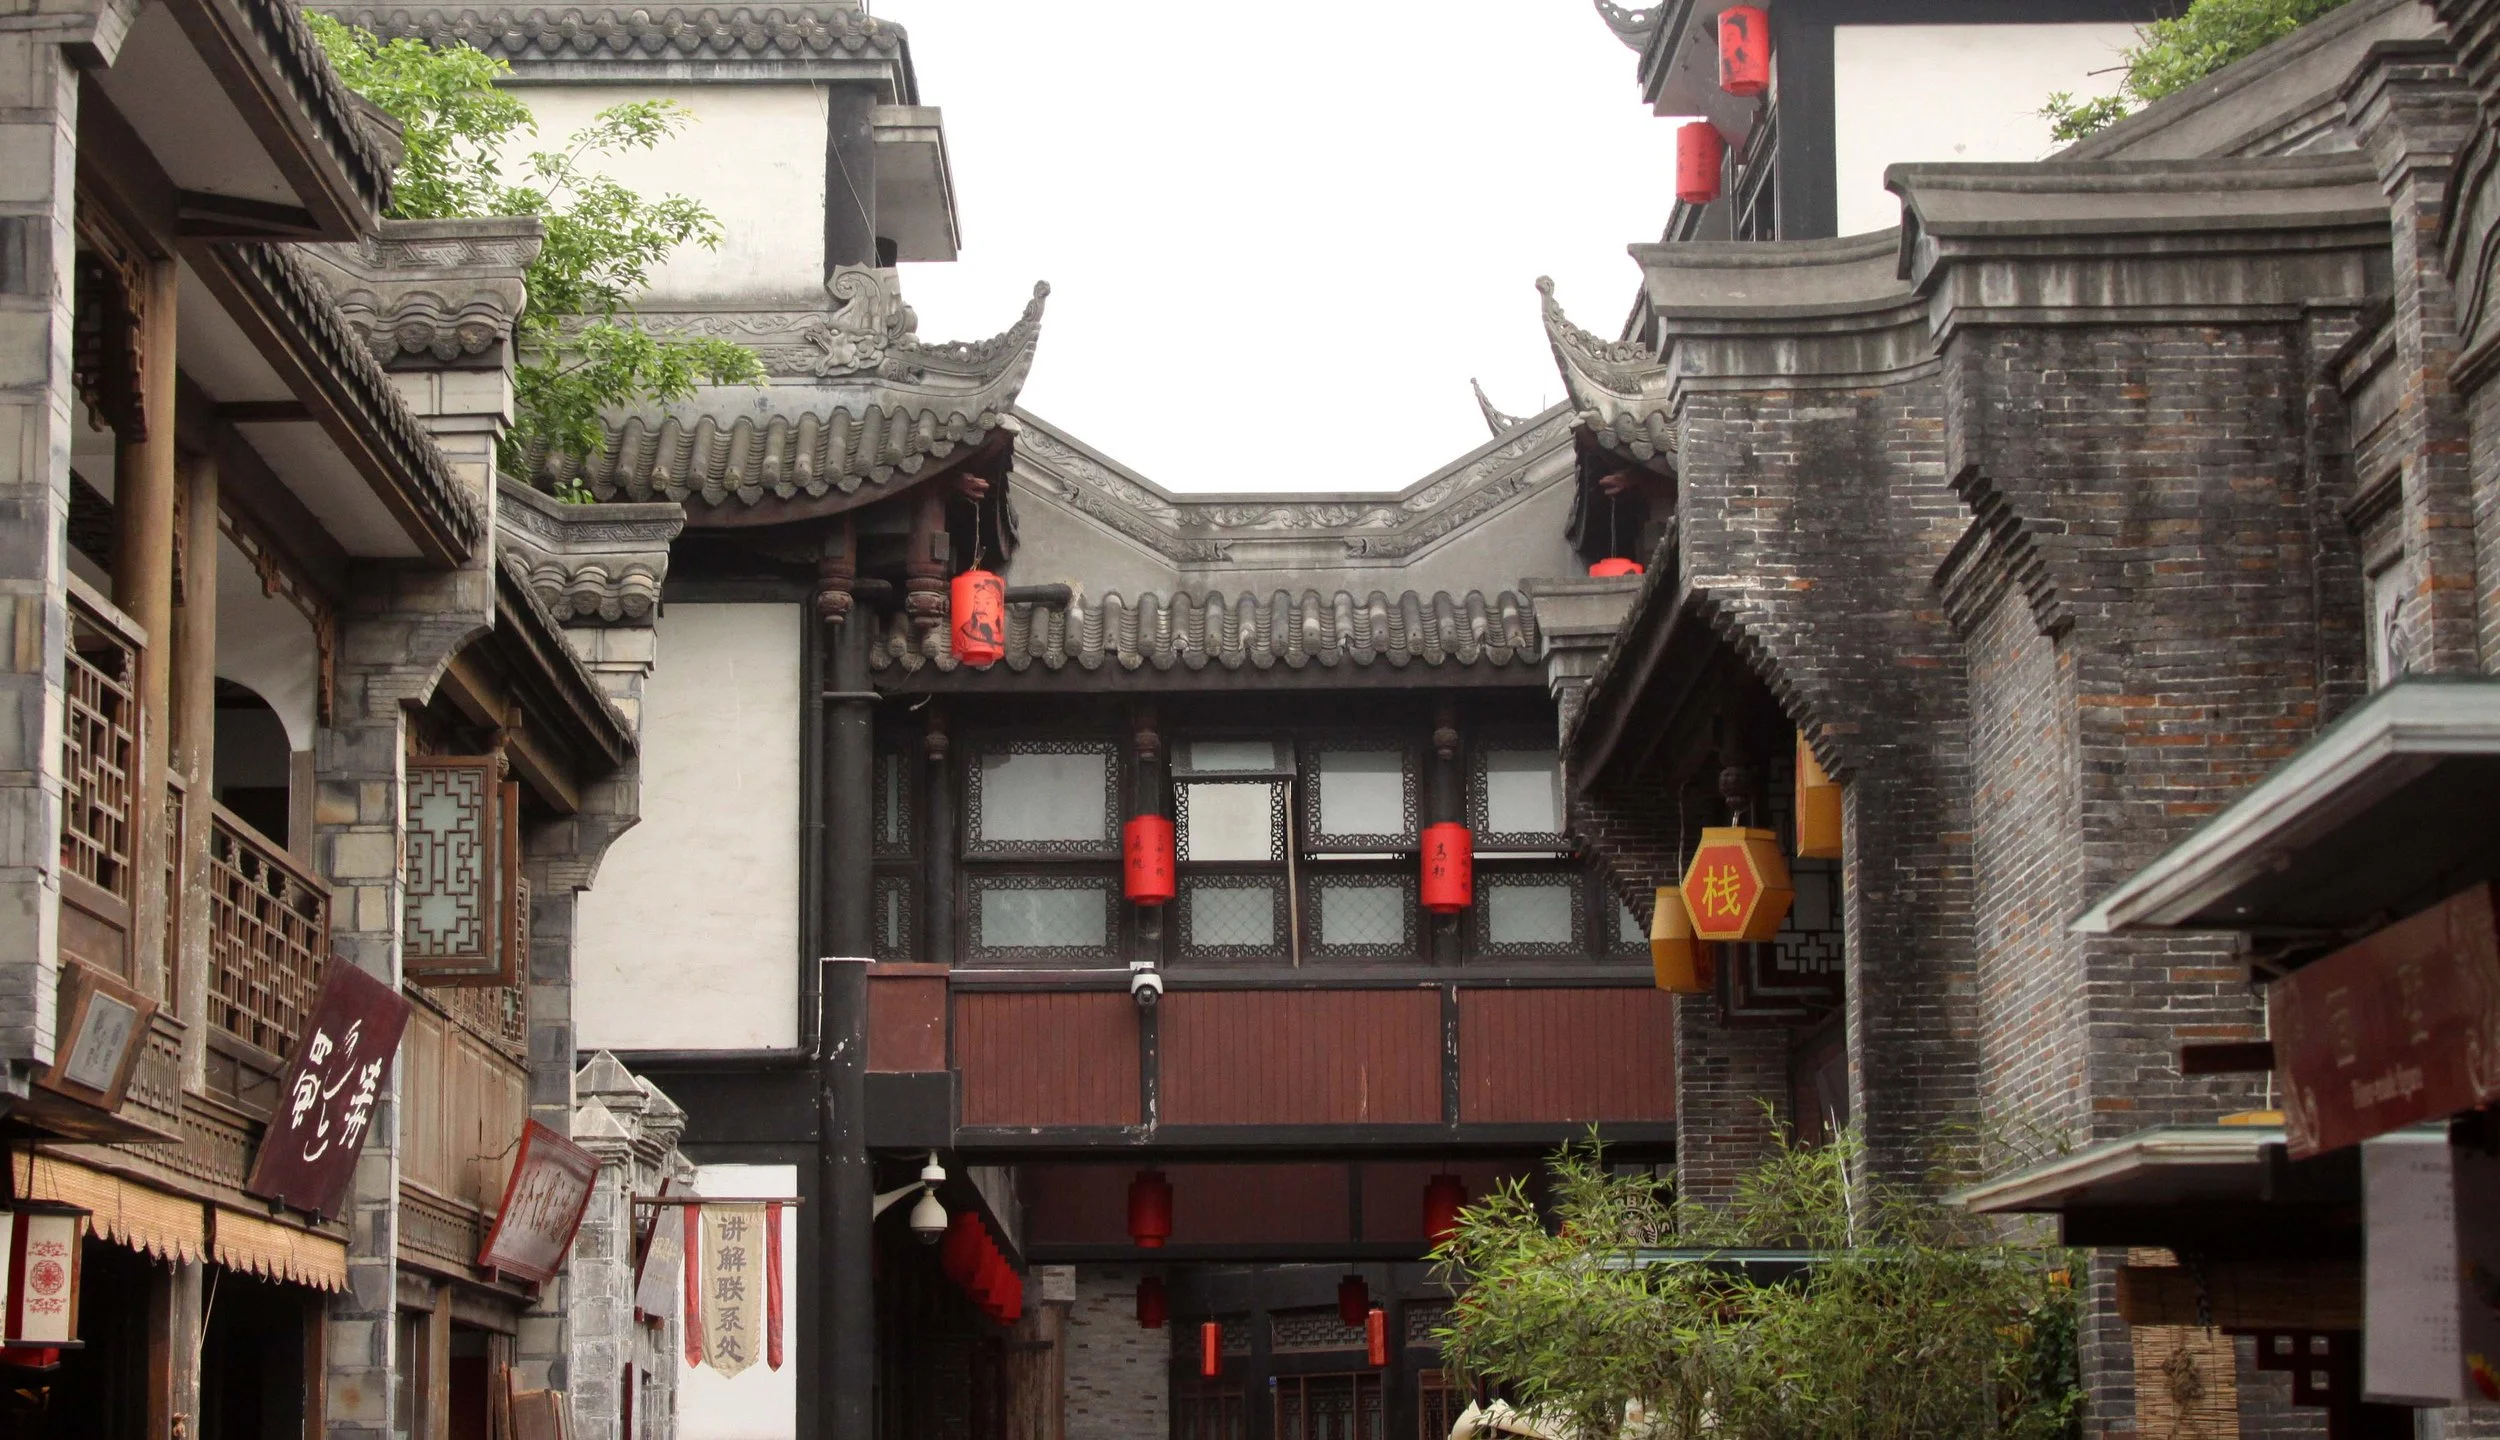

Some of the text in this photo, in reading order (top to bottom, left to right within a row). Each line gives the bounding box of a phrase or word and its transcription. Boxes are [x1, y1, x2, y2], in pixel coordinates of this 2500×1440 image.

[1702, 865, 1741, 918] 栈
[714, 1216, 748, 1363] 讲解联系处
